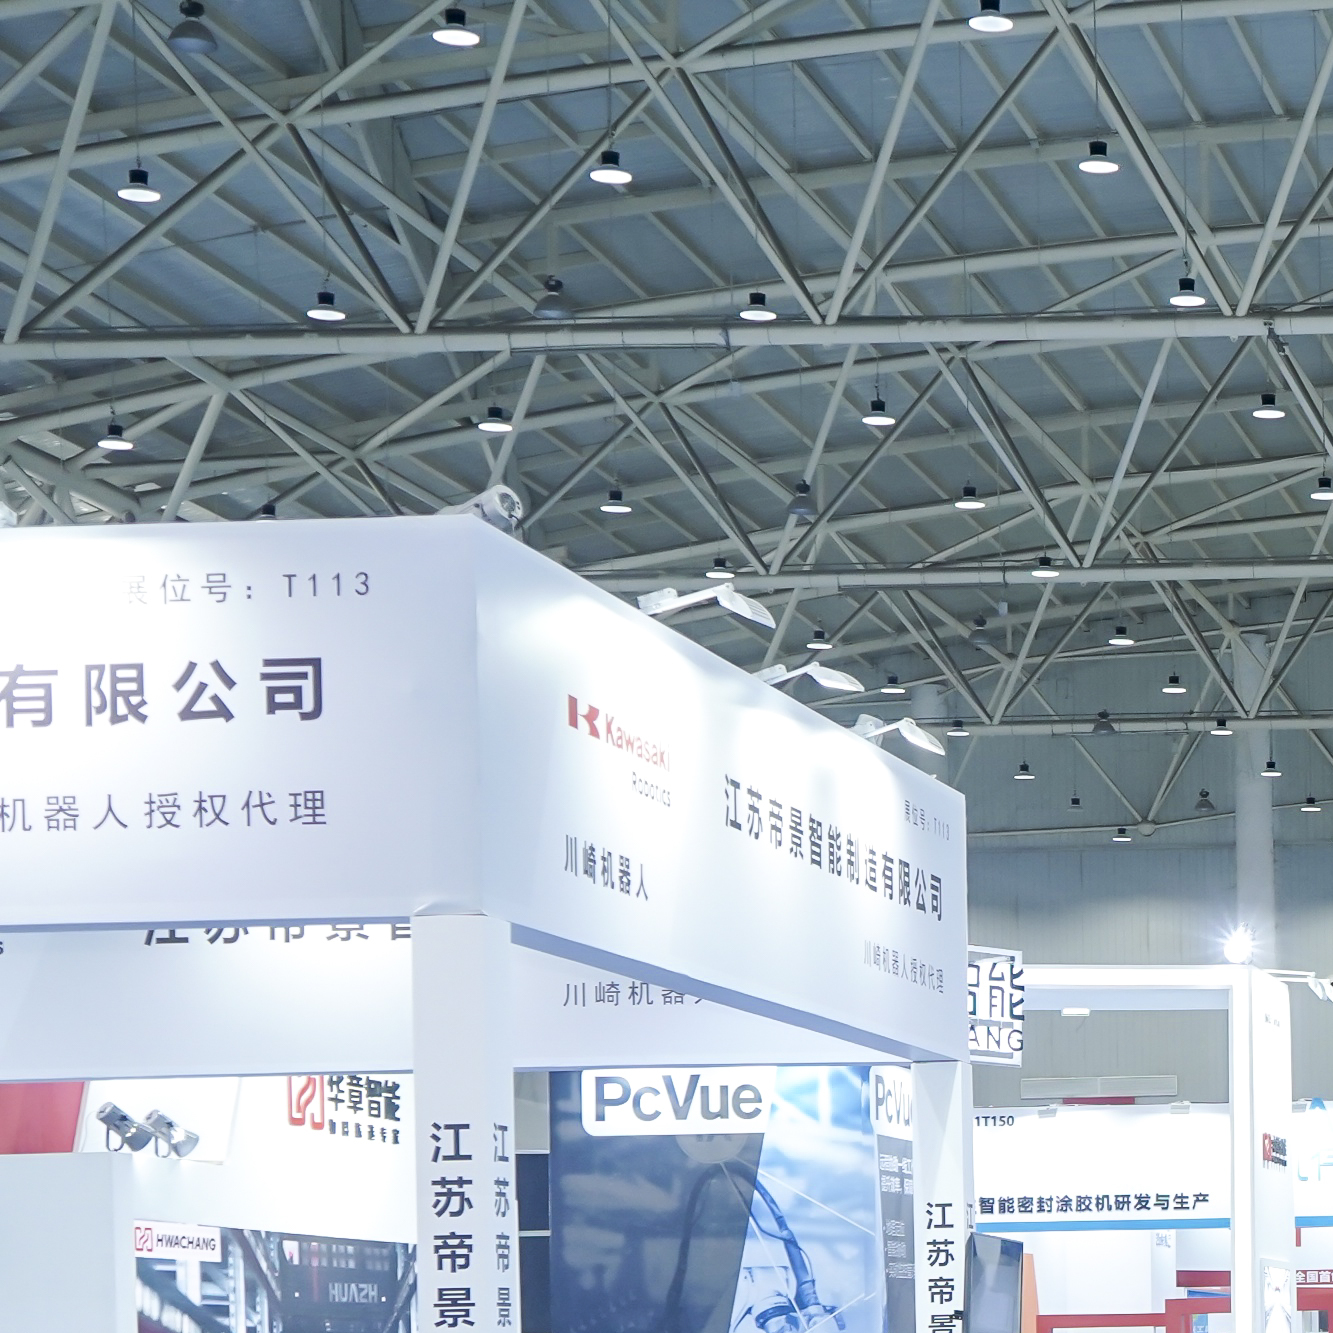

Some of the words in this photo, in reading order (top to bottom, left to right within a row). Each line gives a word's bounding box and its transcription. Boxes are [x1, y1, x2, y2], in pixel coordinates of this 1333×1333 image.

[0, 656, 325, 728] 有限公司
[564, 833, 649, 901] 川崎机器人
[724, 773, 943, 922] 江苏帝景智能制造有限公司
[563, 981, 703, 1007] 川崎机器
[594, 1074, 763, 1122] PcVue
[875, 1074, 913, 1127] PcVu
[977, 1192, 1210, 1215] 智能密封涂胶机研发与生产
[156, 1233, 217, 1251] HWACHANG
